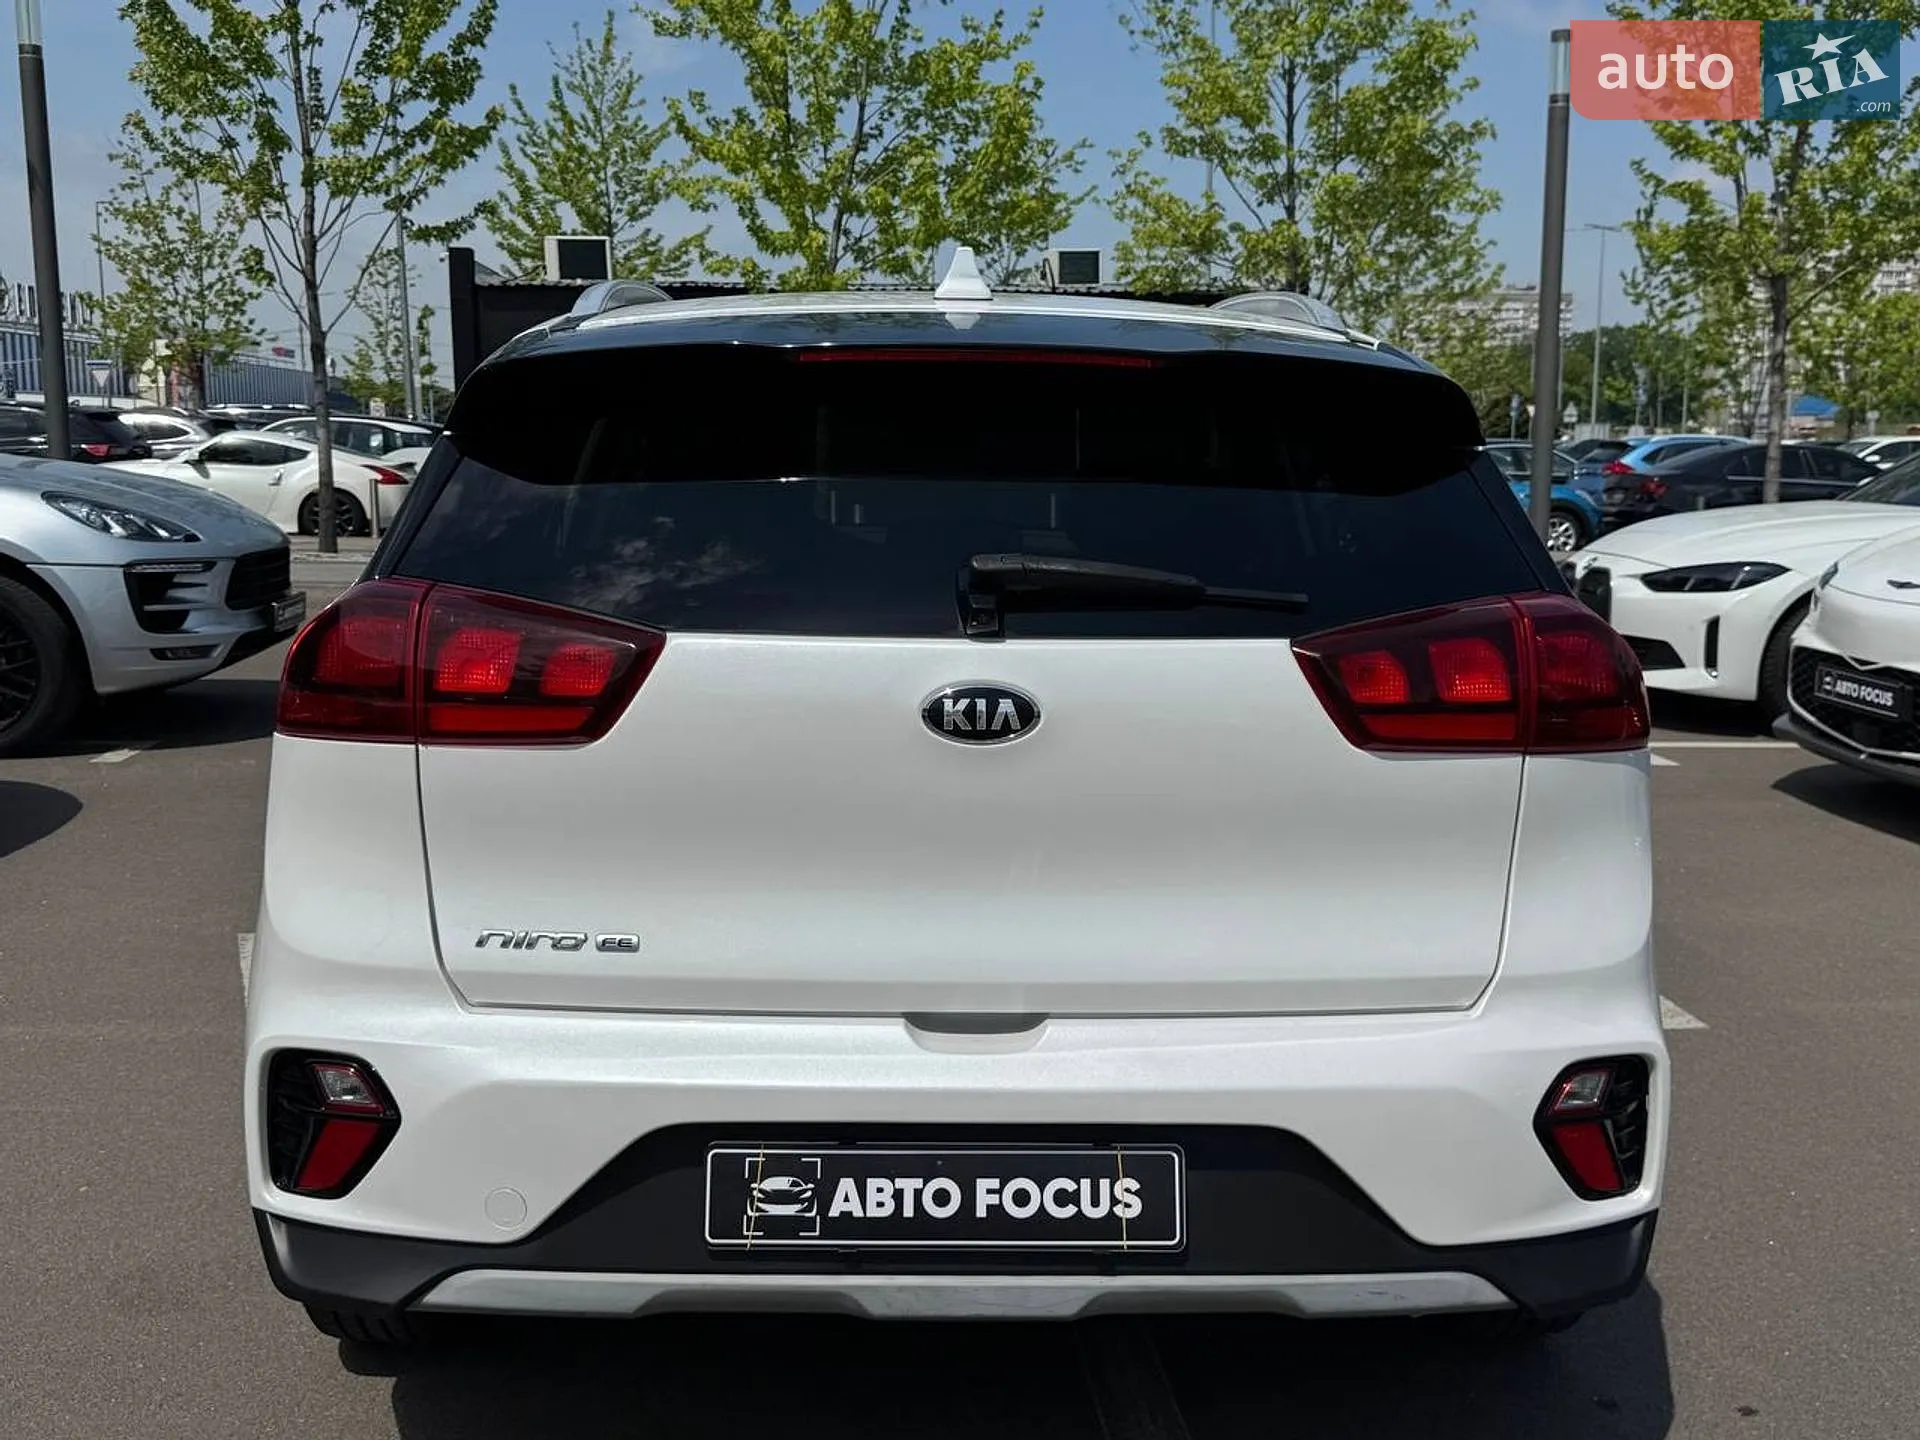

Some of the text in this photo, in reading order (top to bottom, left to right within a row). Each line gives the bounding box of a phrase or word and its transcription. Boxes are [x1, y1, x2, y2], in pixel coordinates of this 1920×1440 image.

[1860, 686, 1893, 706] FOCUS
[942, 698, 1021, 730] KIA
[975, 1177, 1143, 1219] FOCUS
